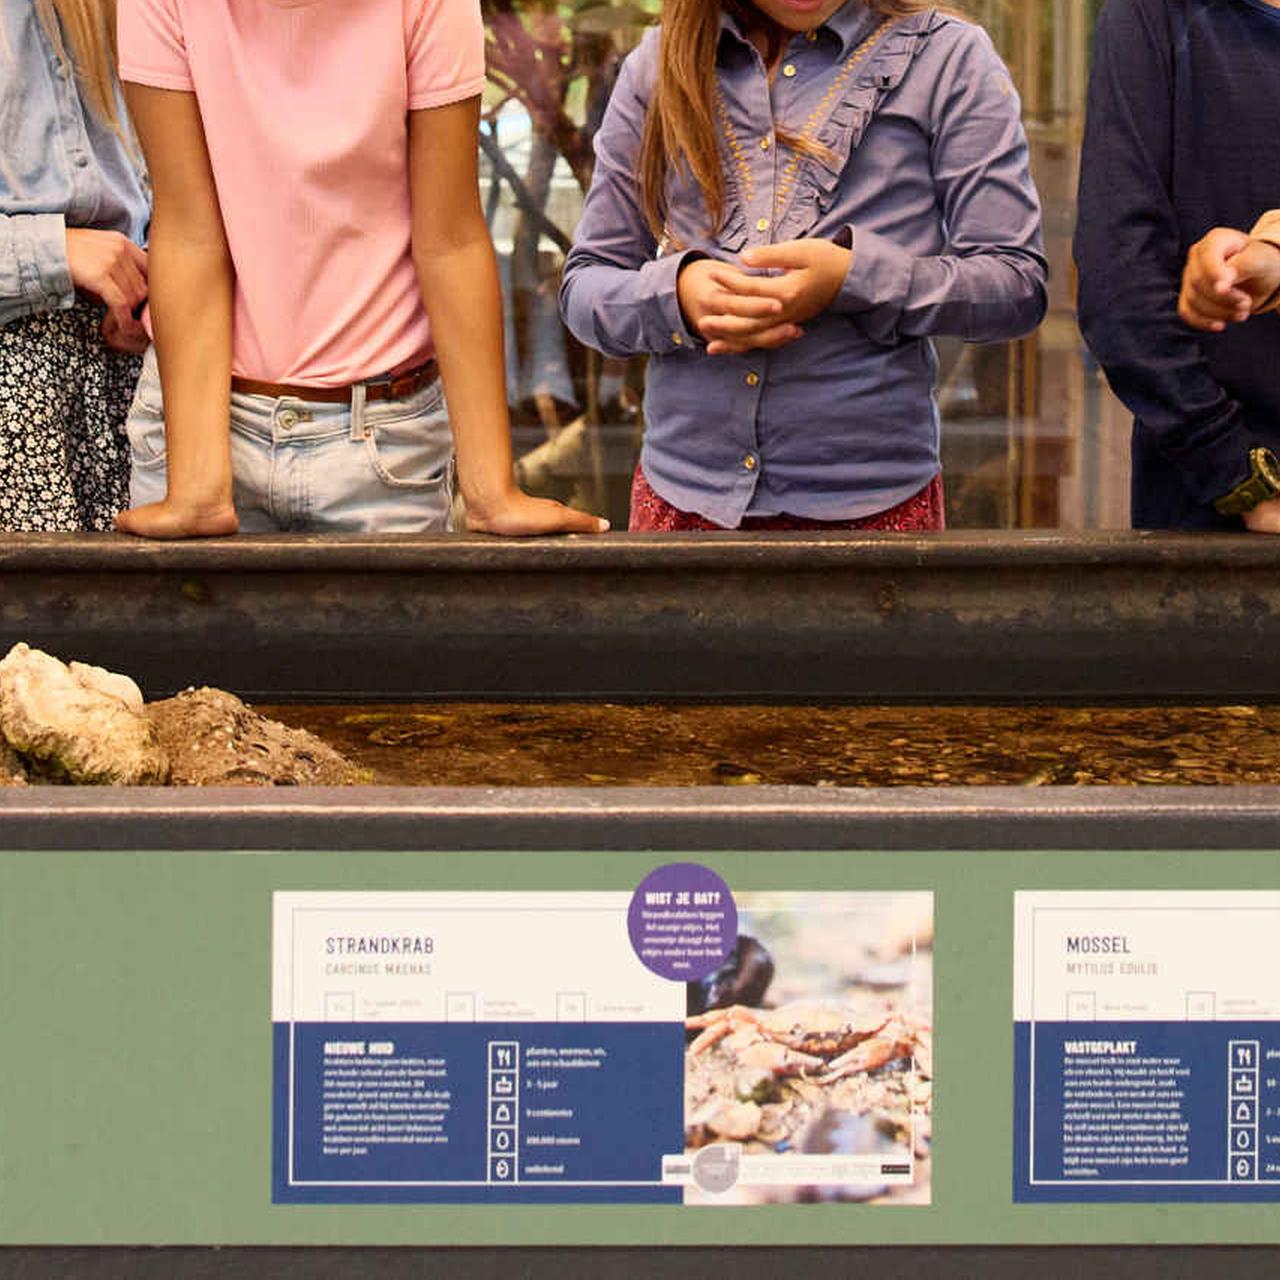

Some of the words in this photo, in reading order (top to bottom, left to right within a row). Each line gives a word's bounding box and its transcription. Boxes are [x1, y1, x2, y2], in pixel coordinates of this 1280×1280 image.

[645, 892, 672, 905] WIST
[675, 892, 690, 905] JE
[325, 937, 434, 954] STRANDKRAB
[1066, 937, 1131, 953] MOSSEL
[1064, 1041, 1137, 1054] VASTGEPLAKT
